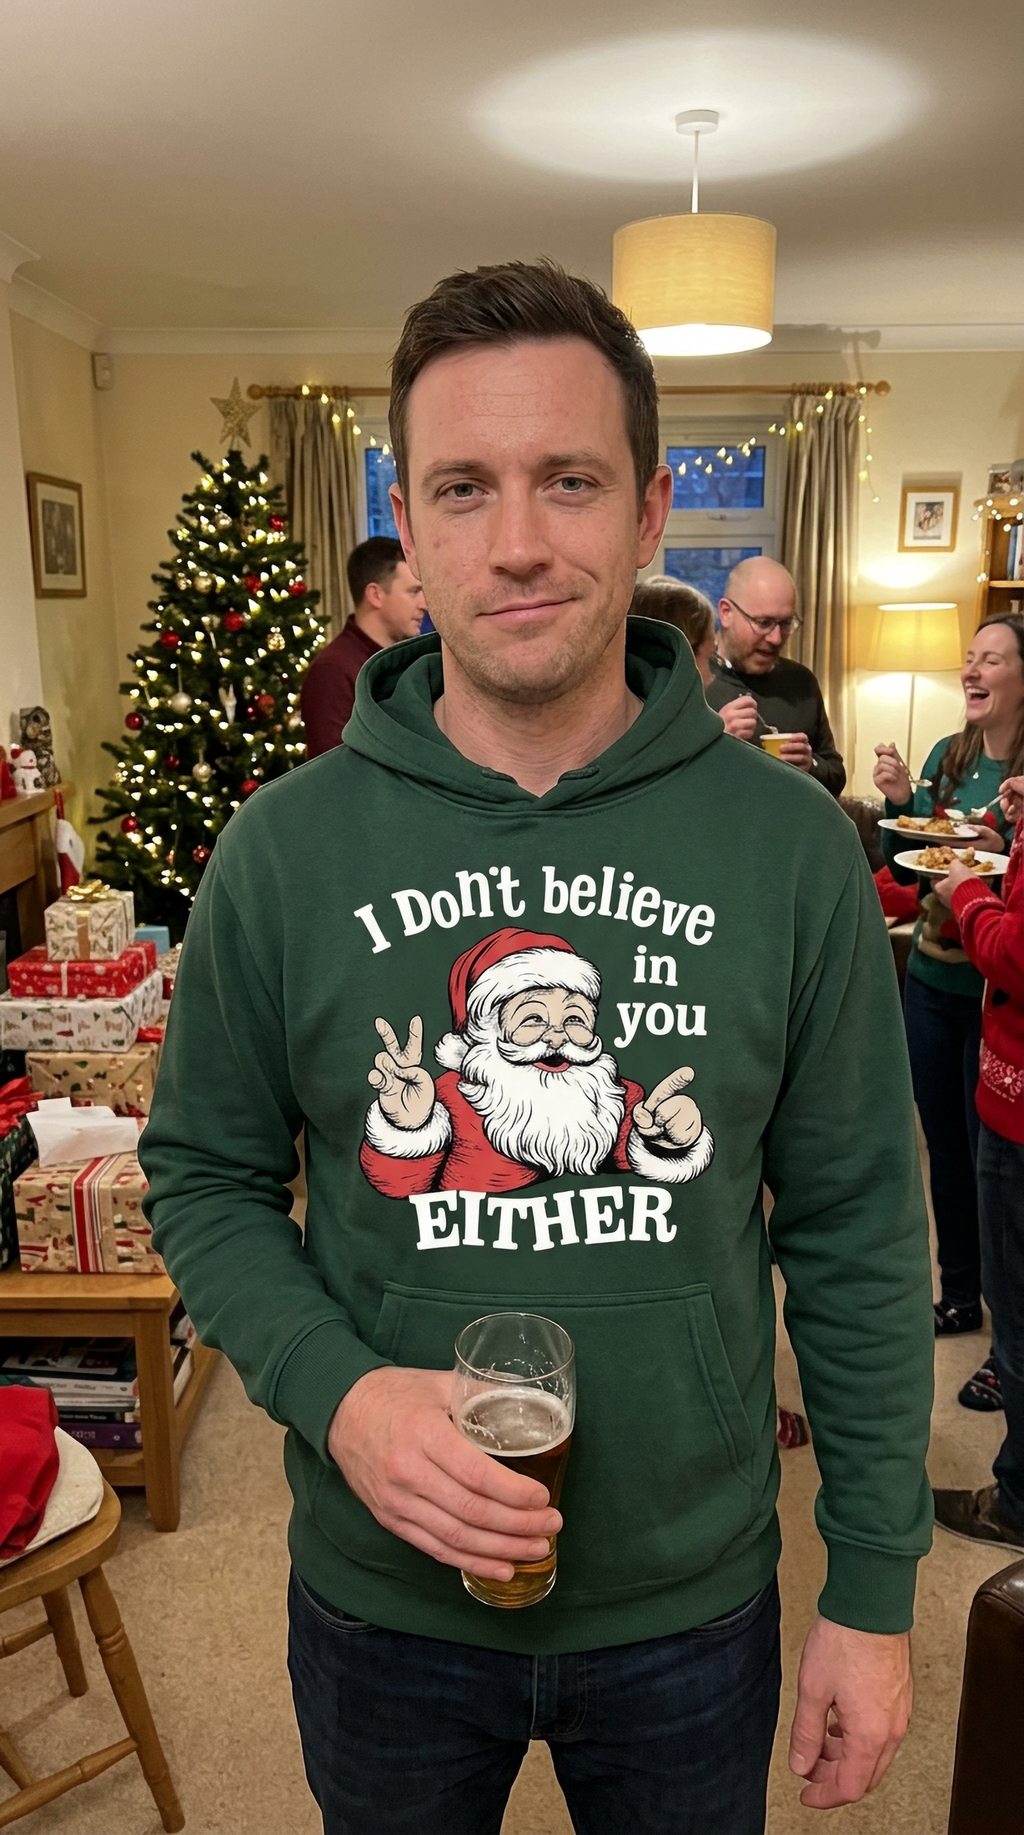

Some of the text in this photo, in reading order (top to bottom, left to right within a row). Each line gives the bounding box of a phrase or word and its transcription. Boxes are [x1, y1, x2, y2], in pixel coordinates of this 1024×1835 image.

[353, 865, 716, 954] I Don't believe
[632, 944, 679, 987] in
[613, 1002, 708, 1049] you
[408, 1185, 678, 1252] EITHER
